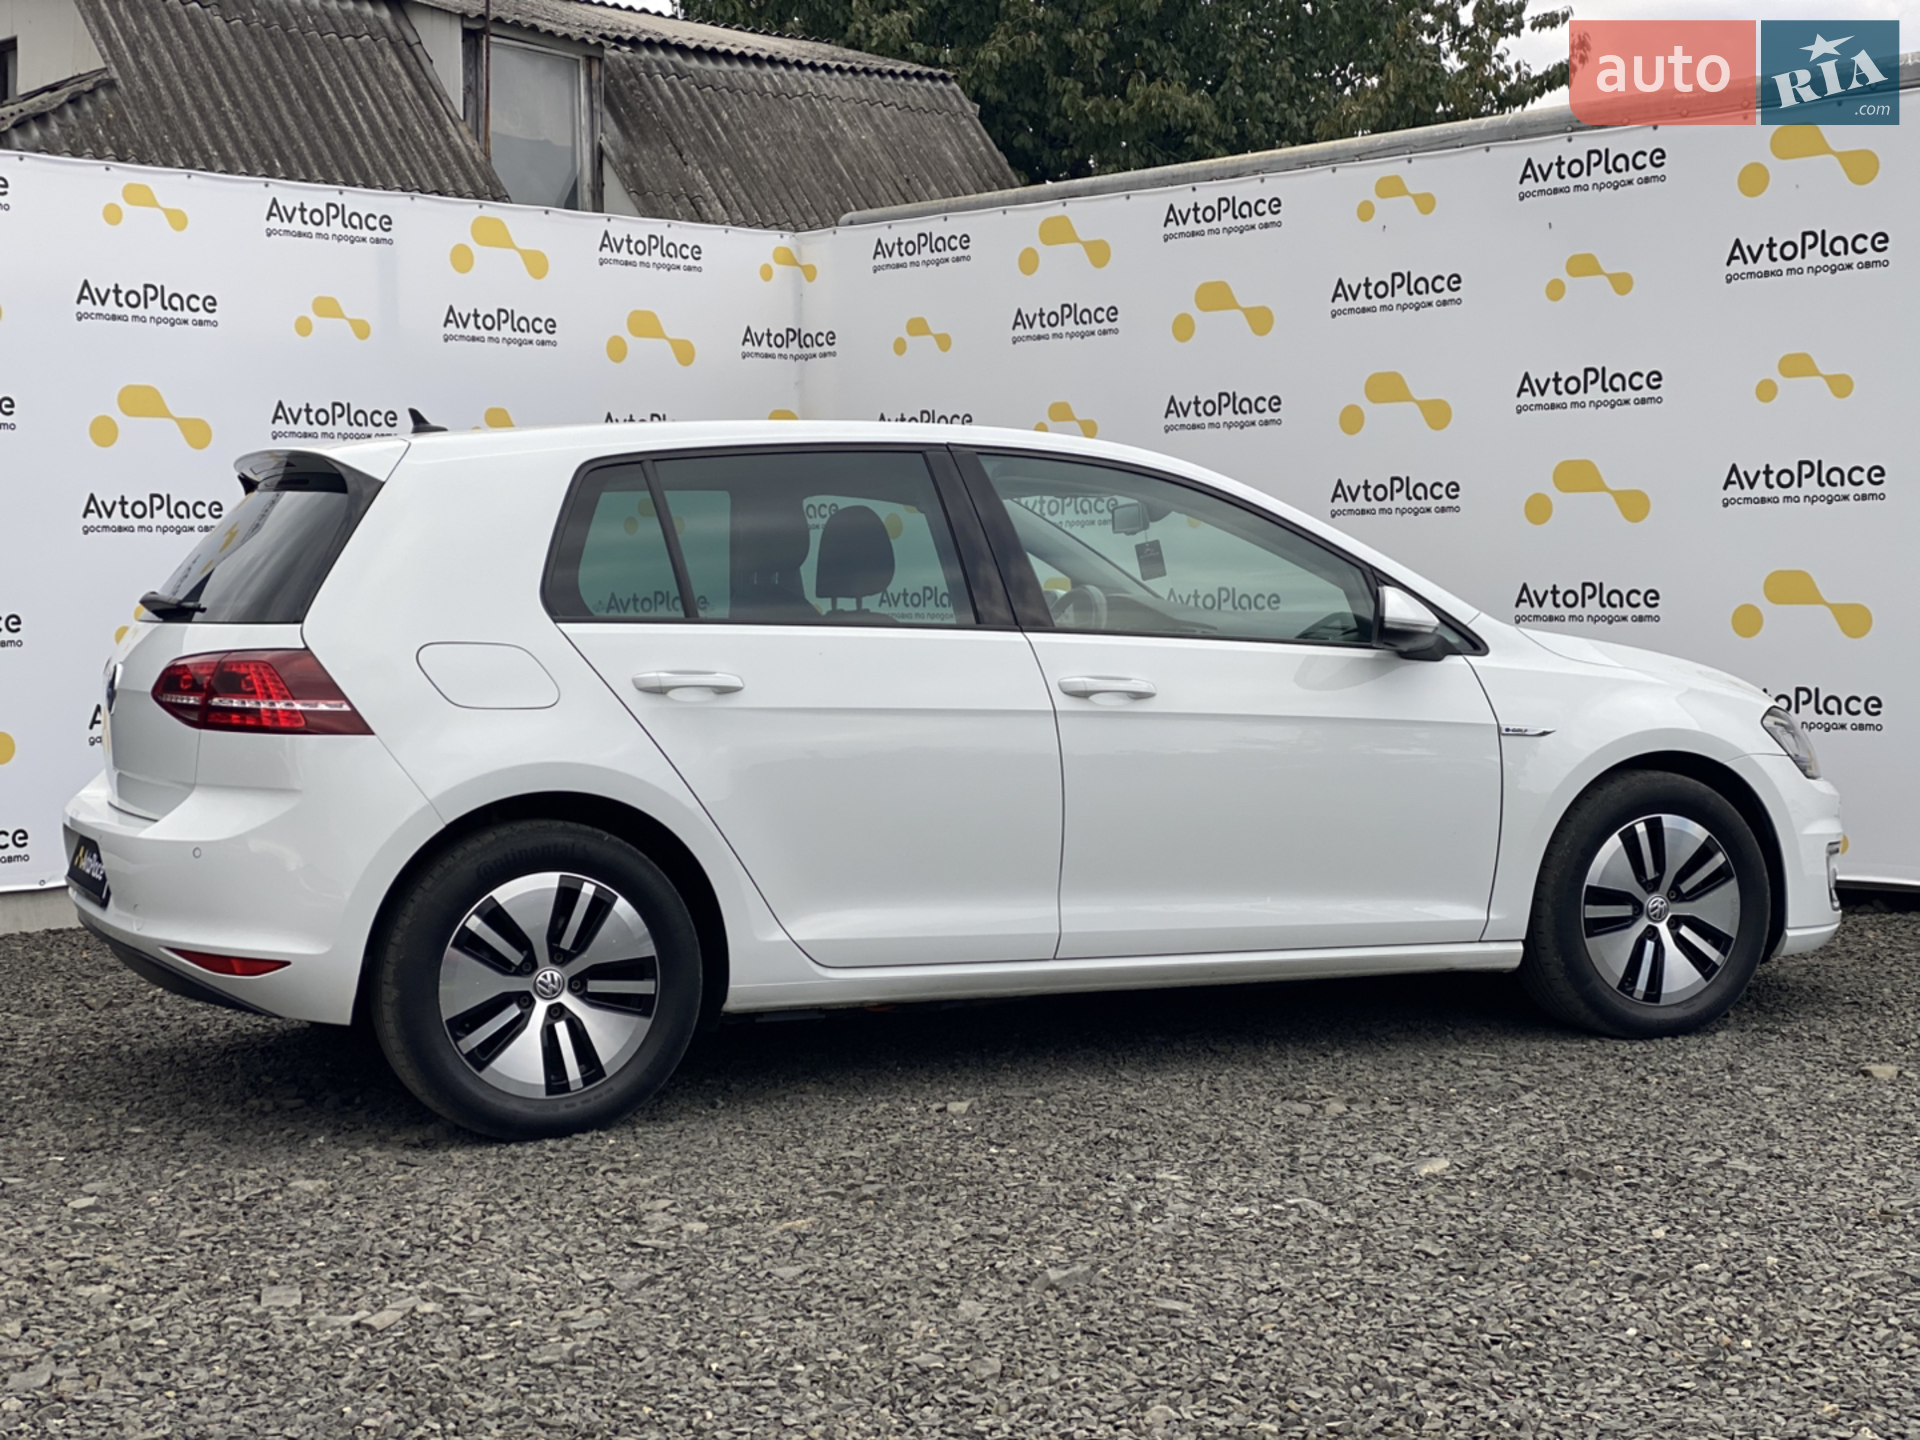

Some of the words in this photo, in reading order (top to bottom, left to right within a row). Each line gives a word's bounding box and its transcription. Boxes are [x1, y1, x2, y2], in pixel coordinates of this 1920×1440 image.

[1519, 148, 1666, 184] AvtoPlace
[1518, 186, 1570, 201] доставка
[1573, 184, 1589, 192] та
[1592, 178, 1634, 193] продаж
[1636, 174, 1666, 185] авто
[266, 197, 392, 232] AvtoPlace
[1164, 196, 1282, 228] AvtoPlace
[266, 228, 313, 239] доставка
[316, 232, 329, 240] та
[332, 234, 367, 244] продаж
[369, 237, 394, 245] авто
[1163, 230, 1205, 242] доставка
[1222, 224, 1256, 235] продаж
[1258, 220, 1282, 230] авто
[599, 230, 702, 260] AvtoPlace
[873, 232, 970, 260] AvtoPlace
[1726, 229, 1889, 267] AvtoPlace
[599, 258, 637, 267] доставка
[652, 262, 680, 272] продаж
[873, 262, 907, 274] доставка
[922, 258, 949, 267] продаж
[951, 255, 971, 263] авто
[1725, 269, 1783, 284] доставка
[1786, 267, 1804, 276] та
[1807, 262, 1854, 276] продаж
[1856, 260, 1890, 270] авто
[76, 279, 217, 314] AvtoPlace
[1331, 271, 1462, 303] AvtoPlace
[76, 312, 128, 322] доставка
[132, 315, 147, 323] та
[150, 316, 188, 327] продаж
[192, 319, 218, 327] авто
[443, 305, 556, 335] AvtoPlace
[1012, 303, 1118, 330] AvtoPlace
[1330, 306, 1377, 319] доставка
[1380, 304, 1394, 312] та
[1396, 301, 1433, 312] продаж
[1436, 298, 1462, 307] авто
[443, 334, 485, 343] доставка
[488, 336, 500, 344] та
[502, 337, 534, 347] продаж
[742, 326, 836, 349] AvtoPlace
[1012, 334, 1050, 344] доставка
[1065, 330, 1095, 339] продаж
[1097, 328, 1119, 336] авто
[789, 353, 817, 362] продаж
[1516, 366, 1663, 398] AvtoPlace
[272, 400, 398, 428] AvtoPlace
[1164, 391, 1282, 419] AvtoPlace
[1516, 402, 1567, 414] доставка
[1589, 398, 1630, 410] продаж
[1633, 396, 1663, 405] авто
[271, 431, 318, 440] доставка
[1164, 423, 1206, 434] доставка
[1223, 420, 1256, 430] продаж
[1258, 418, 1282, 426] авто
[1722, 460, 1886, 491] AvtoPlace
[1331, 476, 1460, 503] AvtoPlace
[1722, 496, 1780, 508] доставка
[1804, 494, 1850, 505] продаж
[1853, 492, 1886, 501] авто
[82, 492, 223, 519] AvtoPlace
[1330, 508, 1376, 518] доставка
[1395, 507, 1432, 516] продаж
[1434, 506, 1460, 514] авто
[82, 525, 135, 535] доставка
[156, 525, 195, 535] продаж
[878, 586, 952, 608] AvtoPla
[1515, 582, 1660, 608] AvtoPlace
[1514, 614, 1566, 624] доставка
[1587, 615, 1628, 625] продаж
[1801, 721, 1847, 732] продаж
[1850, 722, 1883, 732] авто
